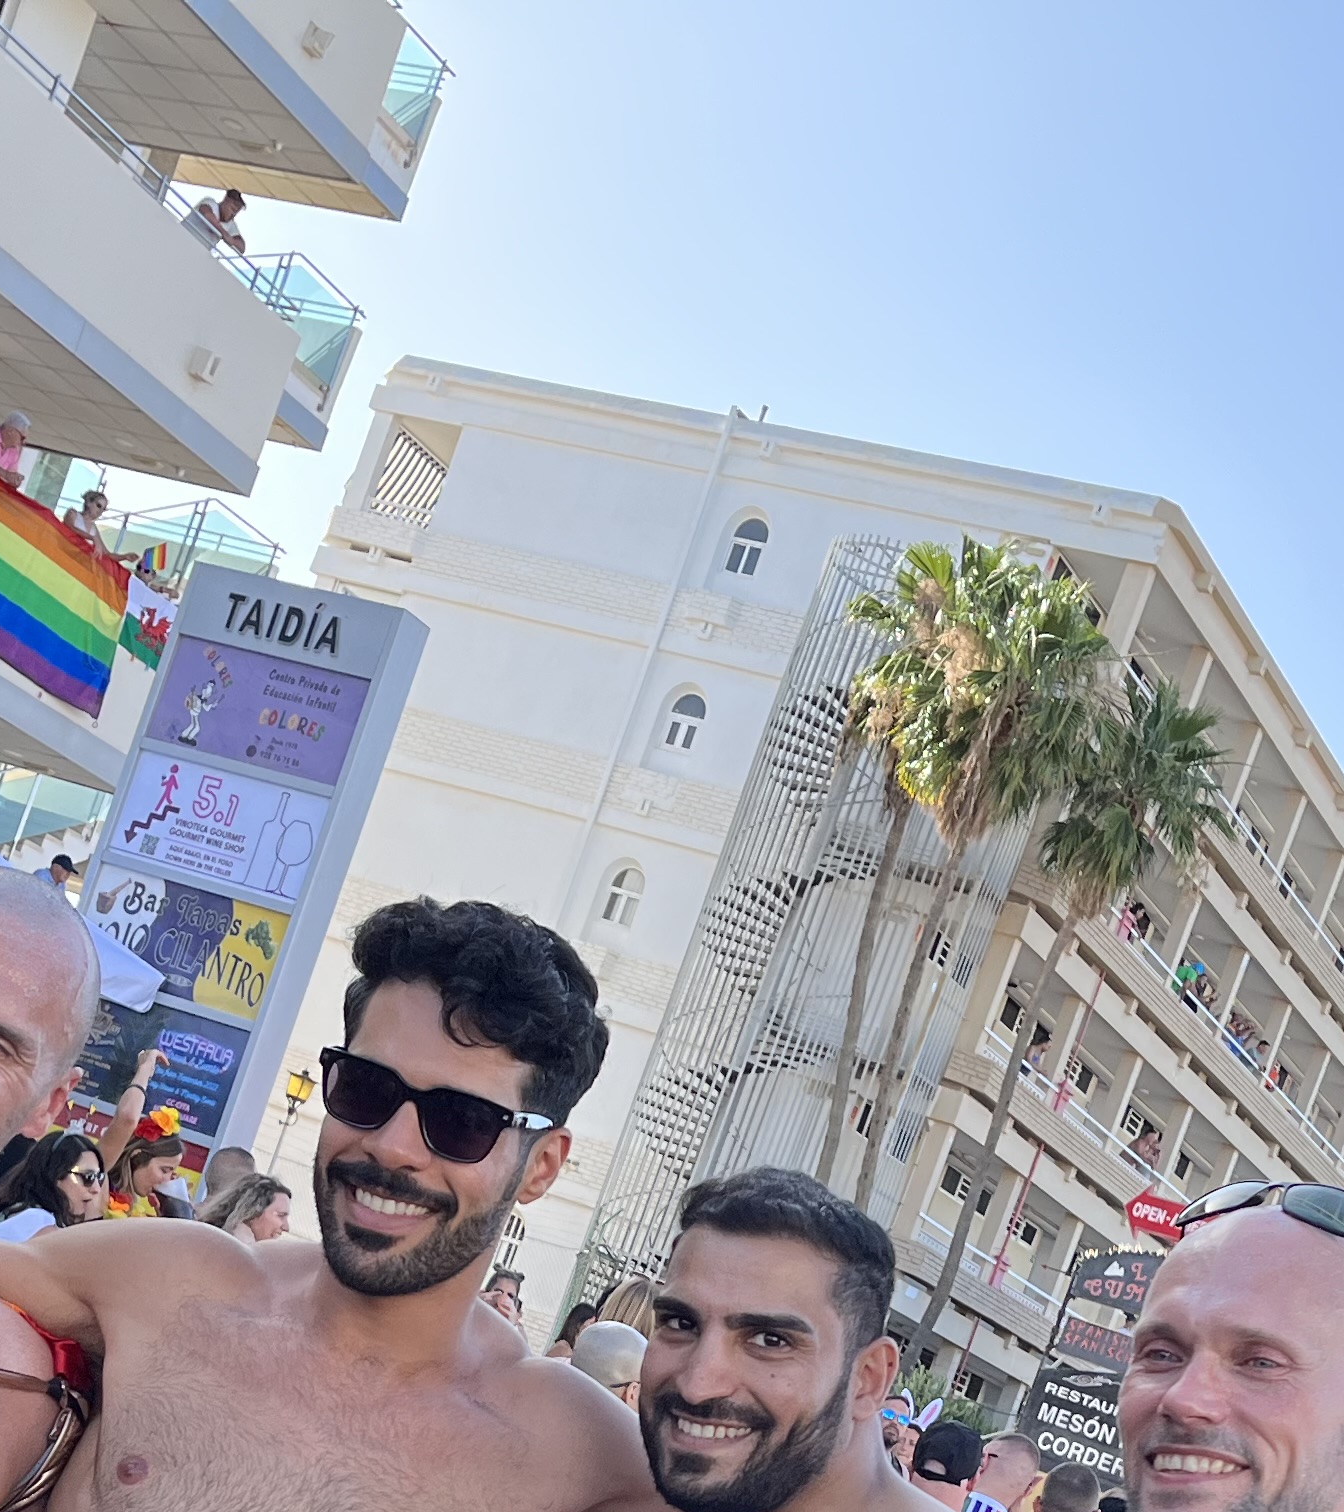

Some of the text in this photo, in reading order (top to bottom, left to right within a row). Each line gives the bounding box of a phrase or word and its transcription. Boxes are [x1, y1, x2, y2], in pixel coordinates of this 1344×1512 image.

[225, 592, 342, 656] TAIDÍA
[263, 684, 338, 713] Educación Infantil
[269, 668, 341, 697] Centro Privado de
[259, 707, 326, 742] COLORES
[192, 775, 240, 827] 5.1
[169, 827, 245, 855] GOURMET WINE SHOP
[175, 818, 247, 843] VINOTECA GOURMET
[123, 881, 243, 936] Bar Tapas
[155, 927, 265, 1008] CILANTRO
[159, 1028, 235, 1067] WESTFALIA
[1037, 1402, 1116, 1445] MESÓN
